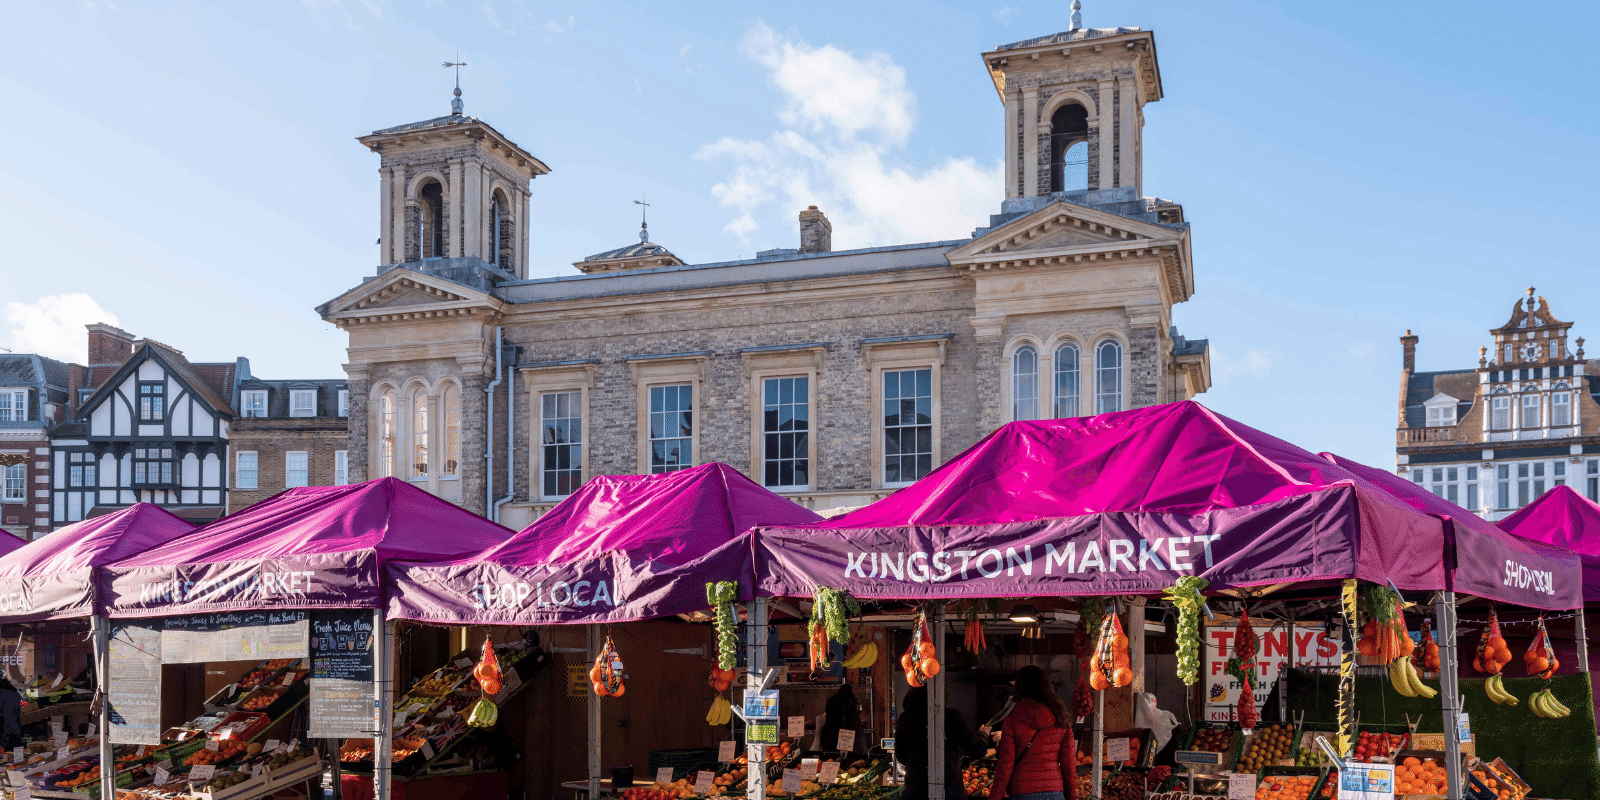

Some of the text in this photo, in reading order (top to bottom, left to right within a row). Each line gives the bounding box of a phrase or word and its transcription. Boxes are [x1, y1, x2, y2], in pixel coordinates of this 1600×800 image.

[844, 534, 1221, 582] KINGSTON MARKET
[140, 570, 315, 604] KINGSTON MARKET
[1504, 560, 1555, 595] SHOP LOCAL
[472, 580, 626, 610] SHOP LOCAL
[314, 619, 373, 633] Fresh Juice Menu
[1211, 631, 1338, 658] TNYS
[0, 655, 23, 666] REE
[1230, 681, 1267, 690] FRH
